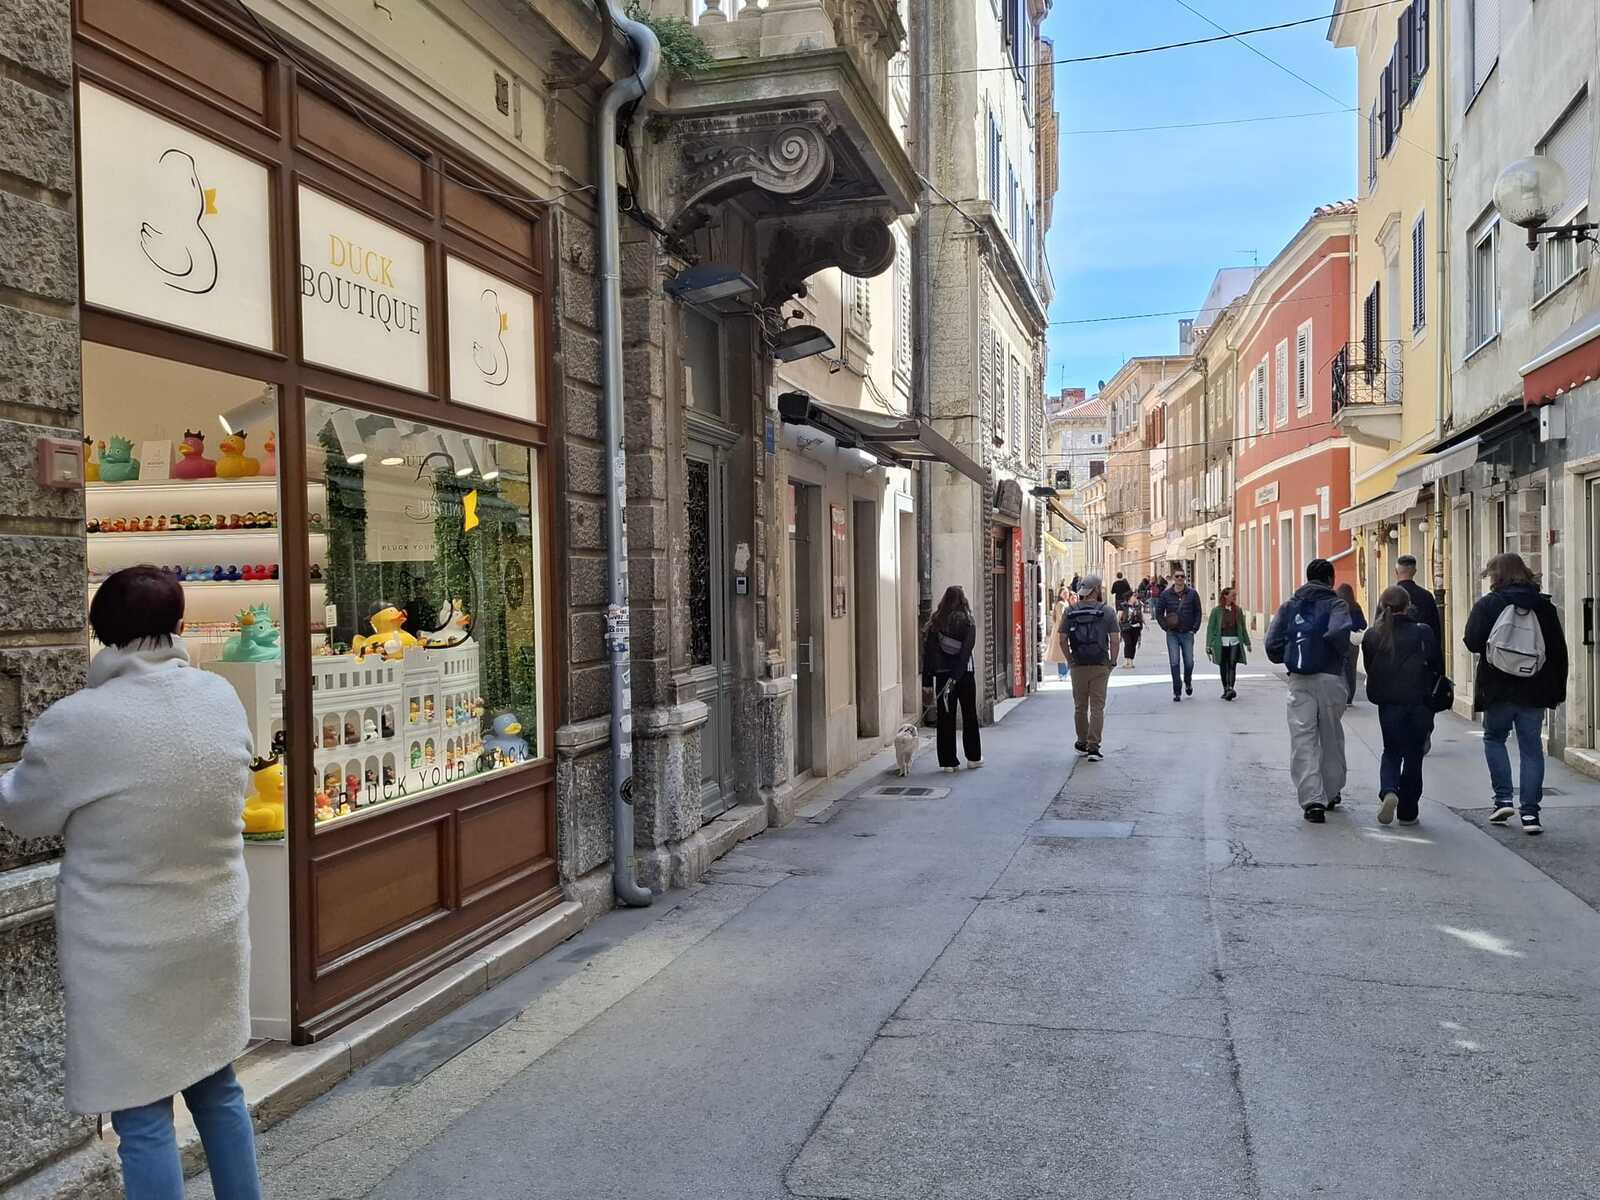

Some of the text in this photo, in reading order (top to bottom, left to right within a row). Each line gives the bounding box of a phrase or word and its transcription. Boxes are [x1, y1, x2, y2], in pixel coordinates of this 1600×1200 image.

[329, 234, 396, 289] DUCK
[300, 264, 420, 334] BOUTIQUE
[338, 744, 527, 811] PLUCK YOUR QUACK
